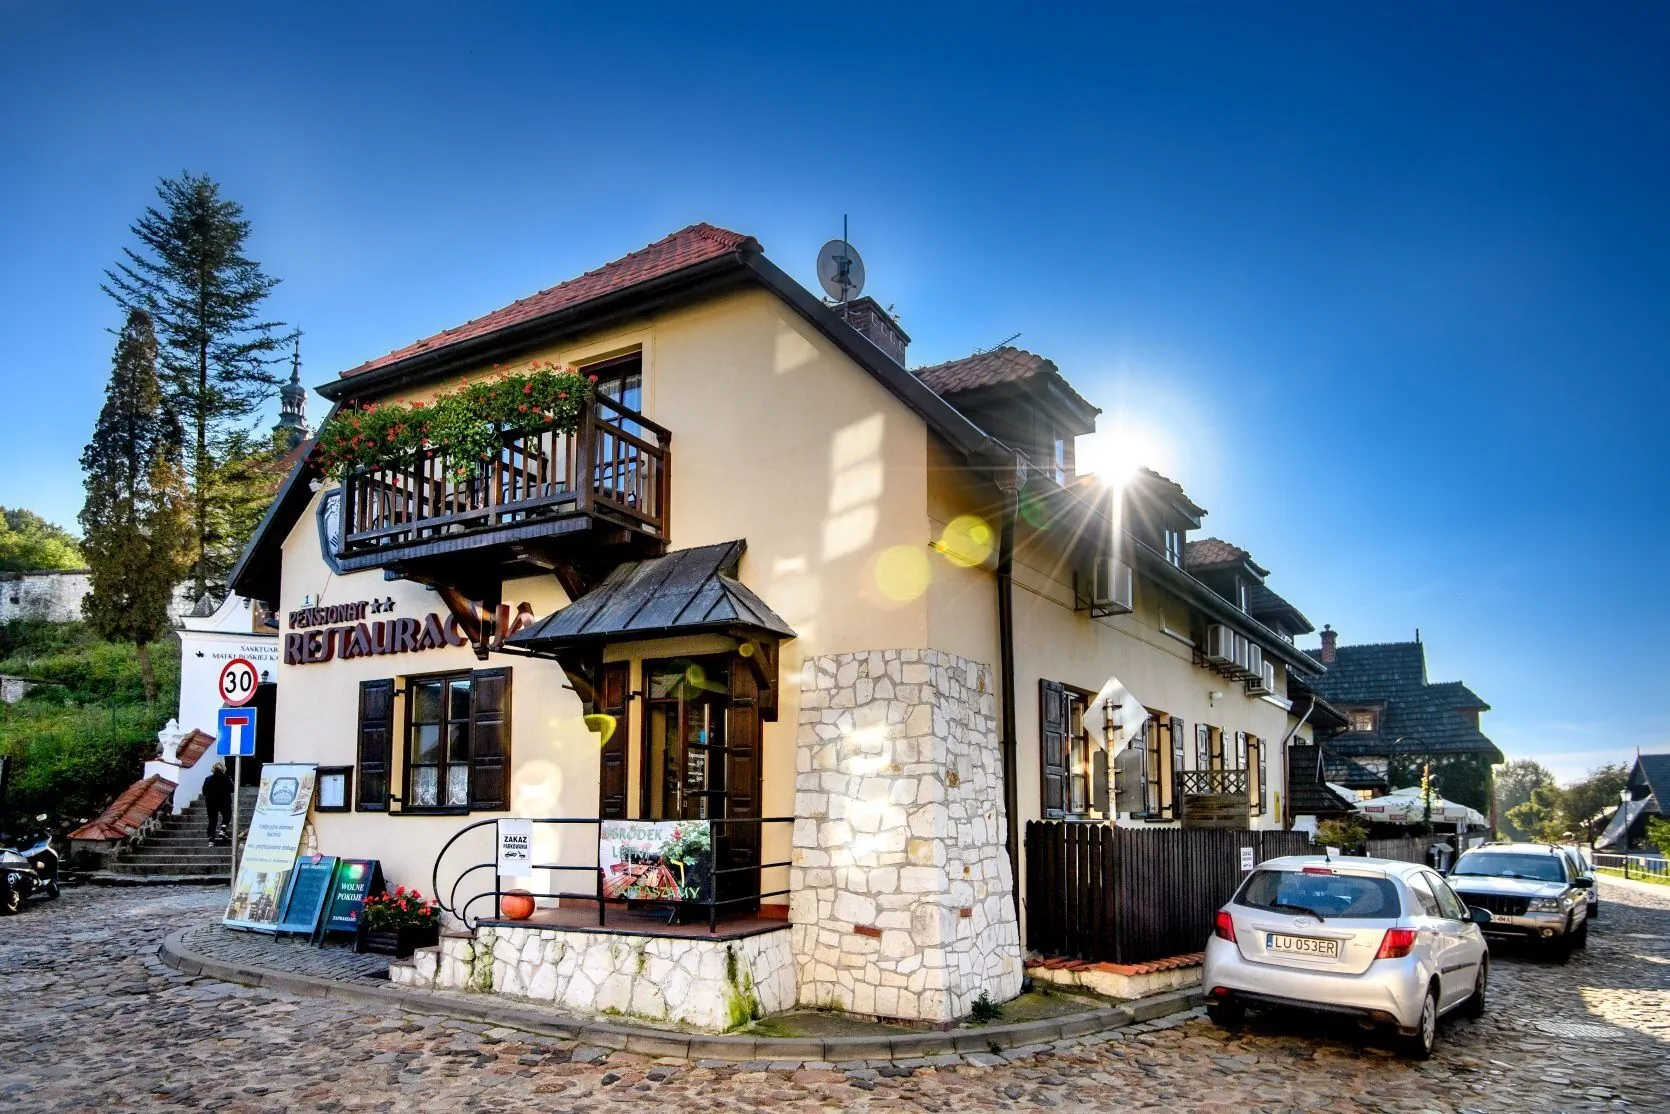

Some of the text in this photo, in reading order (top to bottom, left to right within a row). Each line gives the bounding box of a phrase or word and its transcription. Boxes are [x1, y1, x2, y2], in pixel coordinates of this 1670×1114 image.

[304, 595, 310, 604] 1
[289, 601, 369, 629] PENSJONAT
[224, 670, 252, 693] 30
[341, 883, 365, 891] WOLNE
[337, 893, 363, 902] POKOJE
[1275, 937, 1335, 954] LU 053ER
